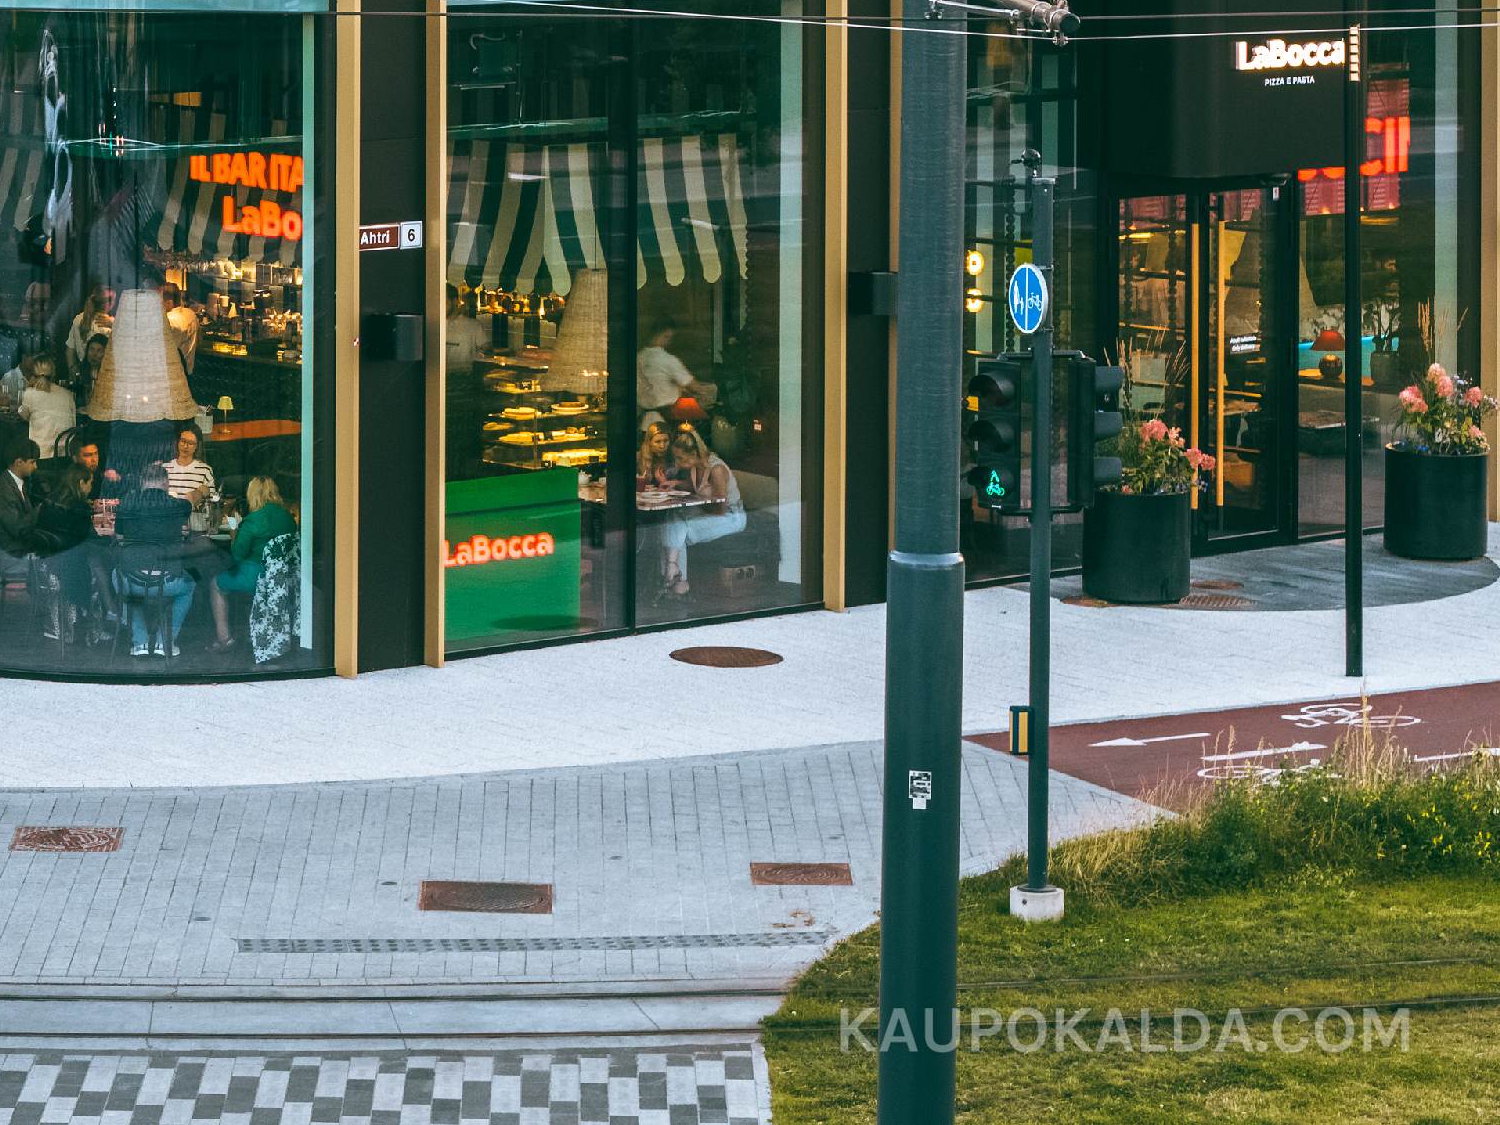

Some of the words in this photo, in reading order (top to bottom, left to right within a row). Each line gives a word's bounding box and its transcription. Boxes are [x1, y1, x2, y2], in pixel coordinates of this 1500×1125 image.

[1236, 38, 1345, 70] LaBocca
[1264, 77, 1285, 87] PIZZA
[1292, 76, 1315, 85] PASTA
[190, 155, 211, 182] IL
[212, 152, 267, 190] BAR
[269, 154, 304, 192] ITA
[222, 195, 303, 242] LaBo
[360, 230, 390, 245] Ahtri
[407, 228, 416, 242] 6
[443, 532, 555, 568] LaBocca
